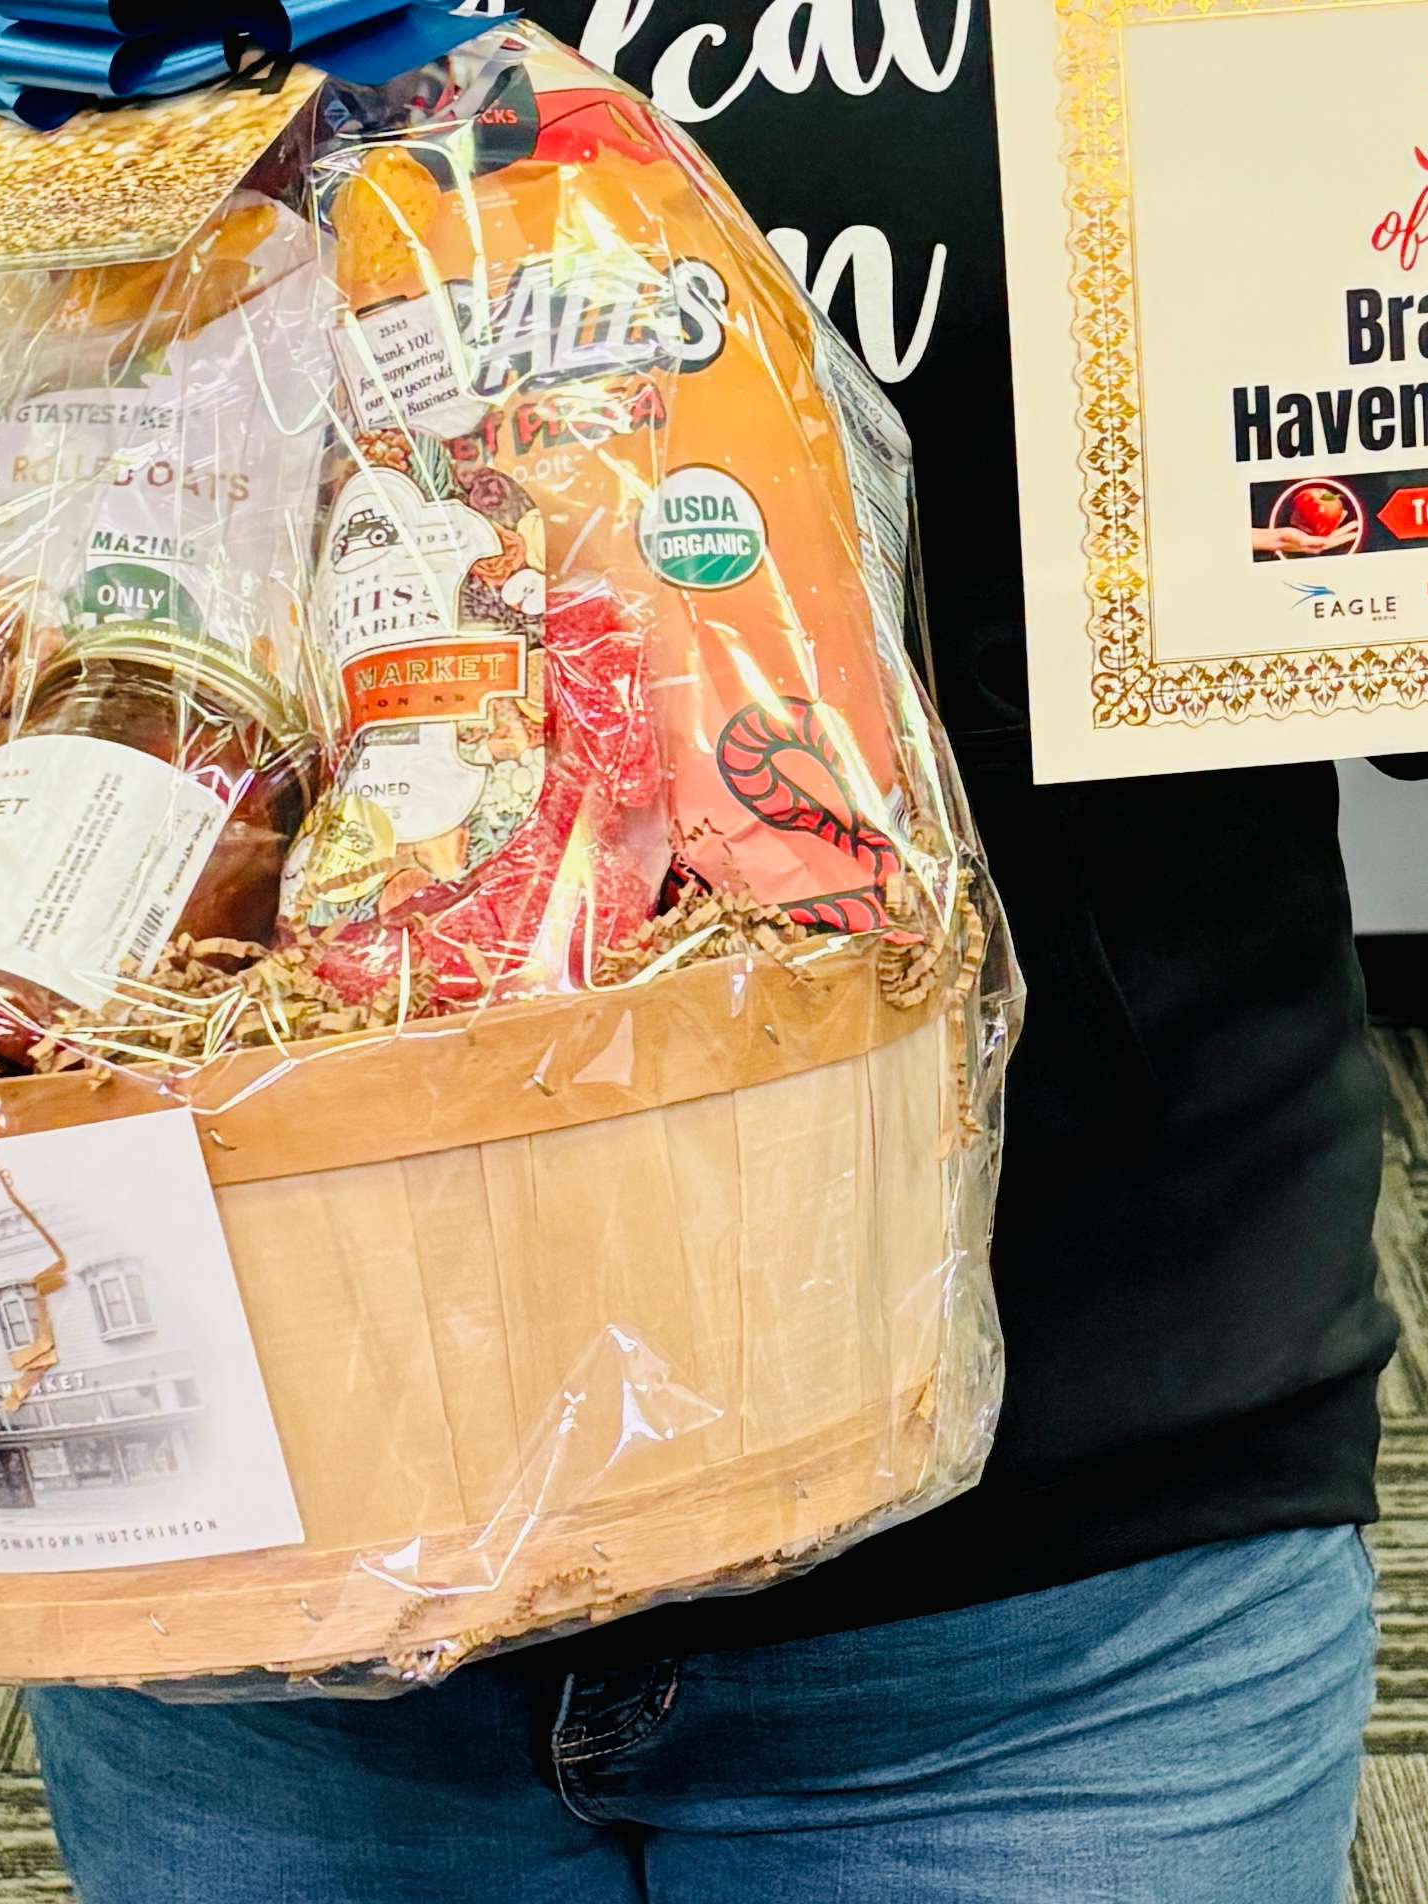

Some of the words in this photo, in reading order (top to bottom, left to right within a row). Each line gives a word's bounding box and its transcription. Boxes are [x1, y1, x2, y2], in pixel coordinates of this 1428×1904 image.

[407, 330, 435, 352] YOU
[405, 387, 459, 416] Business
[664, 495, 739, 524] USDA
[659, 533, 752, 560] ORGANIC
[97, 584, 164, 610] ONLY
[1314, 595, 1397, 619] EAGLE
[355, 653, 507, 696] MARKET
[95, 1519, 217, 1545] HUTCHINSON
